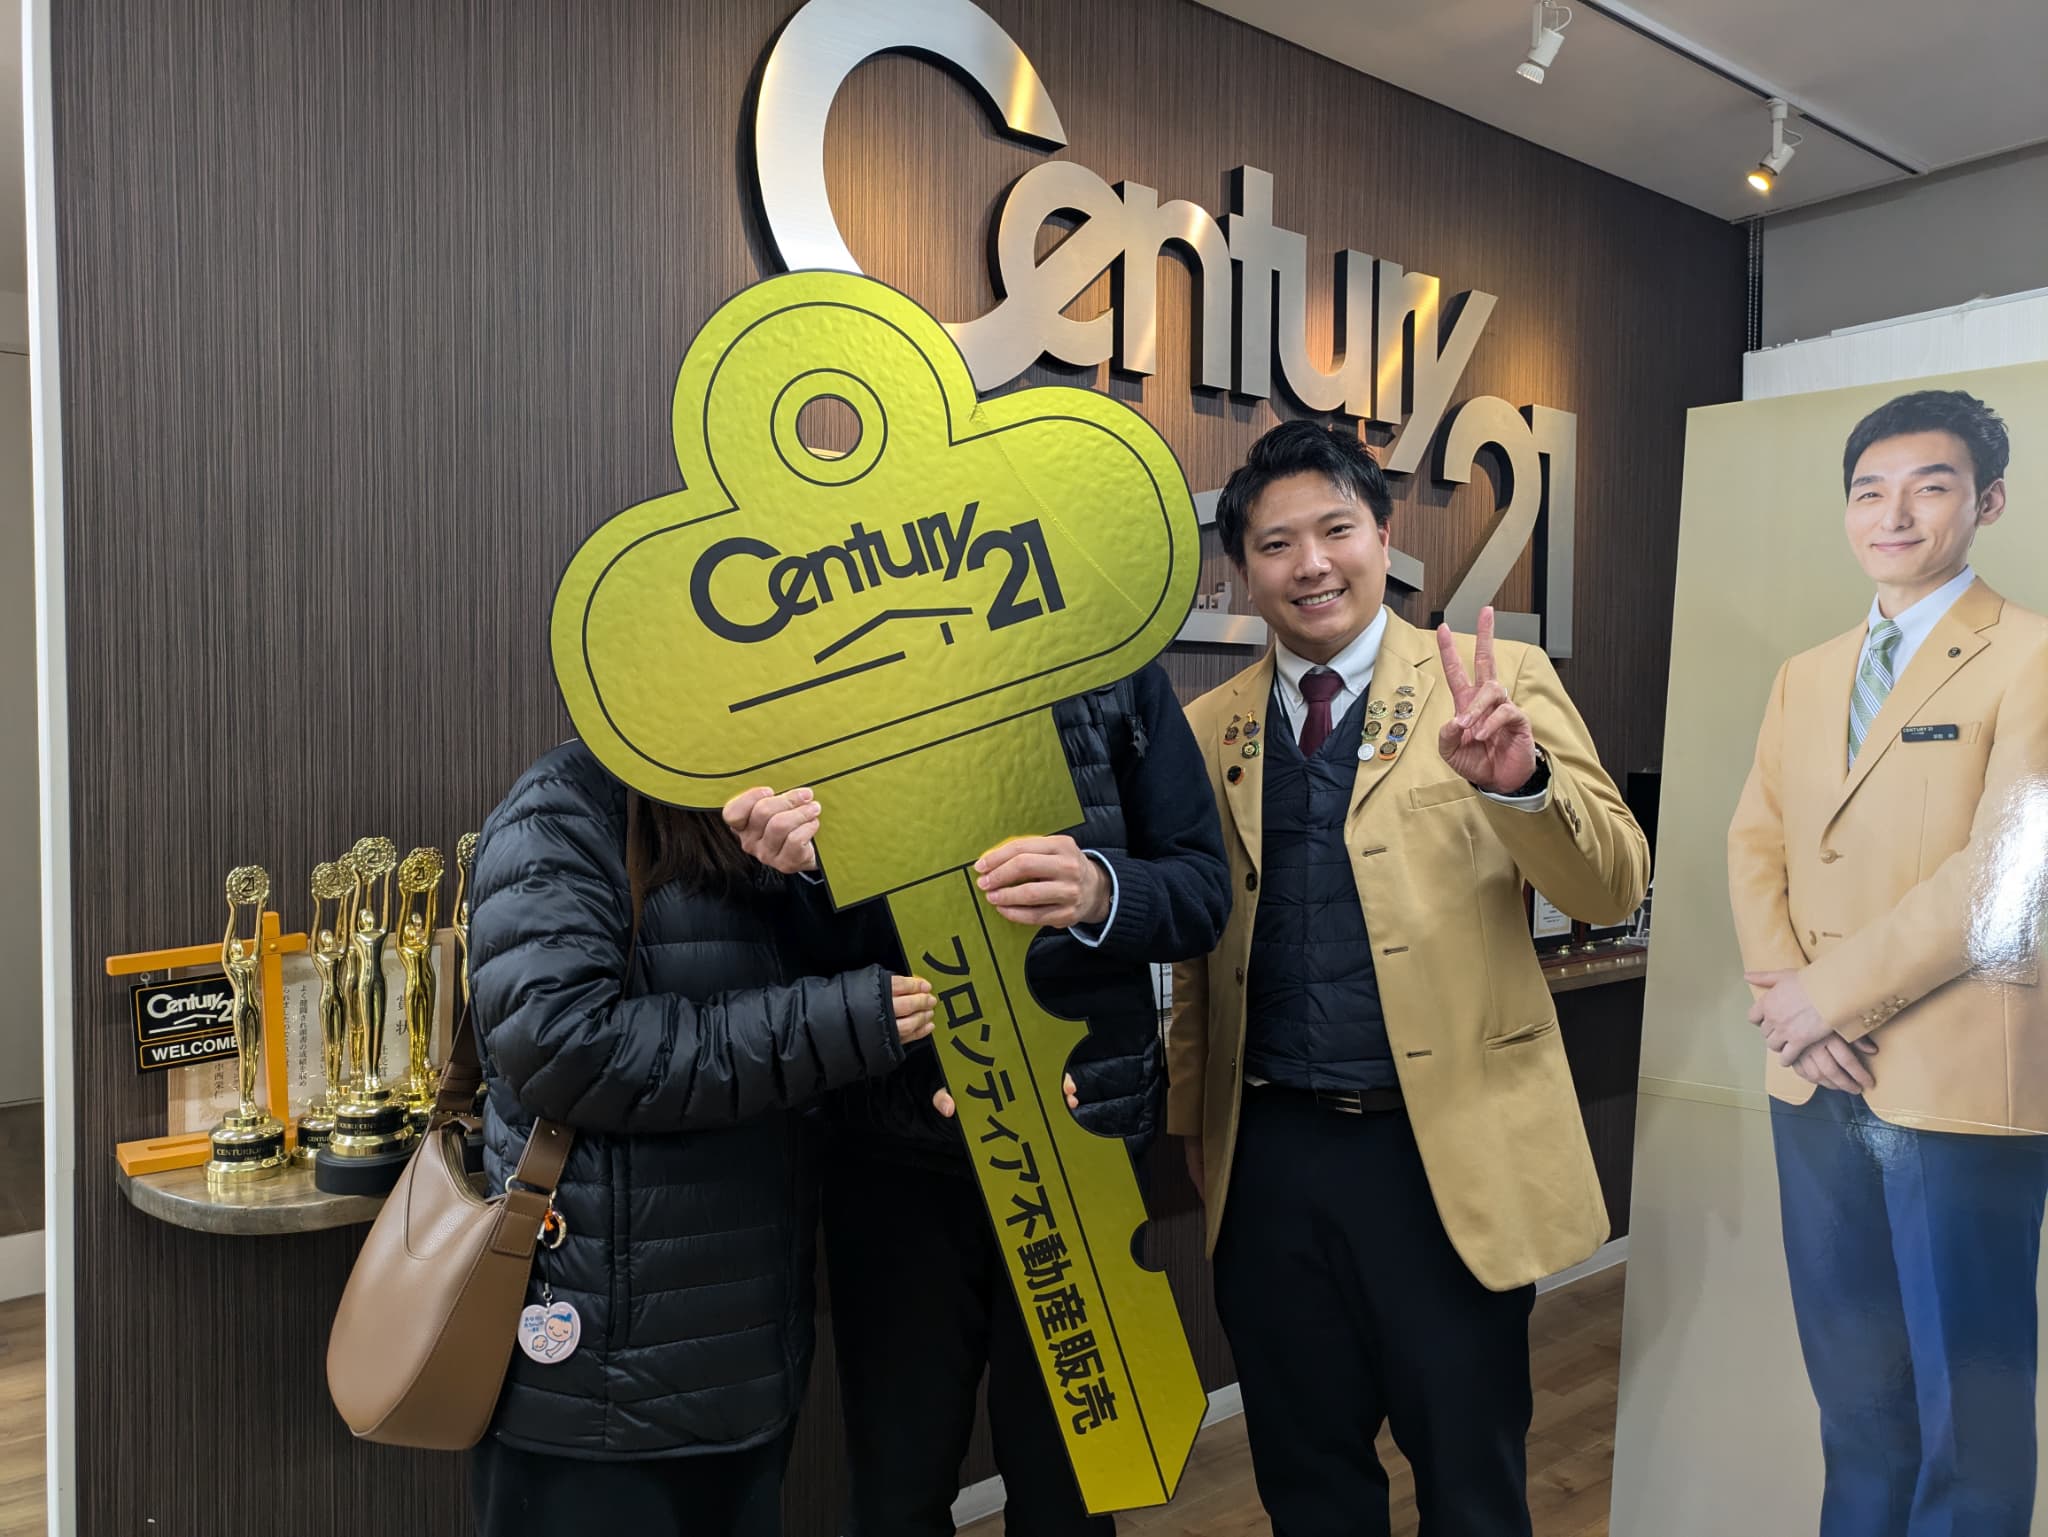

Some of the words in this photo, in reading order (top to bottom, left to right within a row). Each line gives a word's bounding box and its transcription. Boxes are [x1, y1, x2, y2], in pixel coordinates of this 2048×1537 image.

[754, 0, 1497, 473] Century
[1437, 394, 1578, 659] 21
[689, 500, 980, 644] Century
[965, 518, 1066, 631] 21
[146, 991, 225, 1019] Century
[216, 998, 235, 1023] 2
[151, 1035, 240, 1061] WELCOME
[922, 934, 1118, 1436] フロンティア不動産販売
